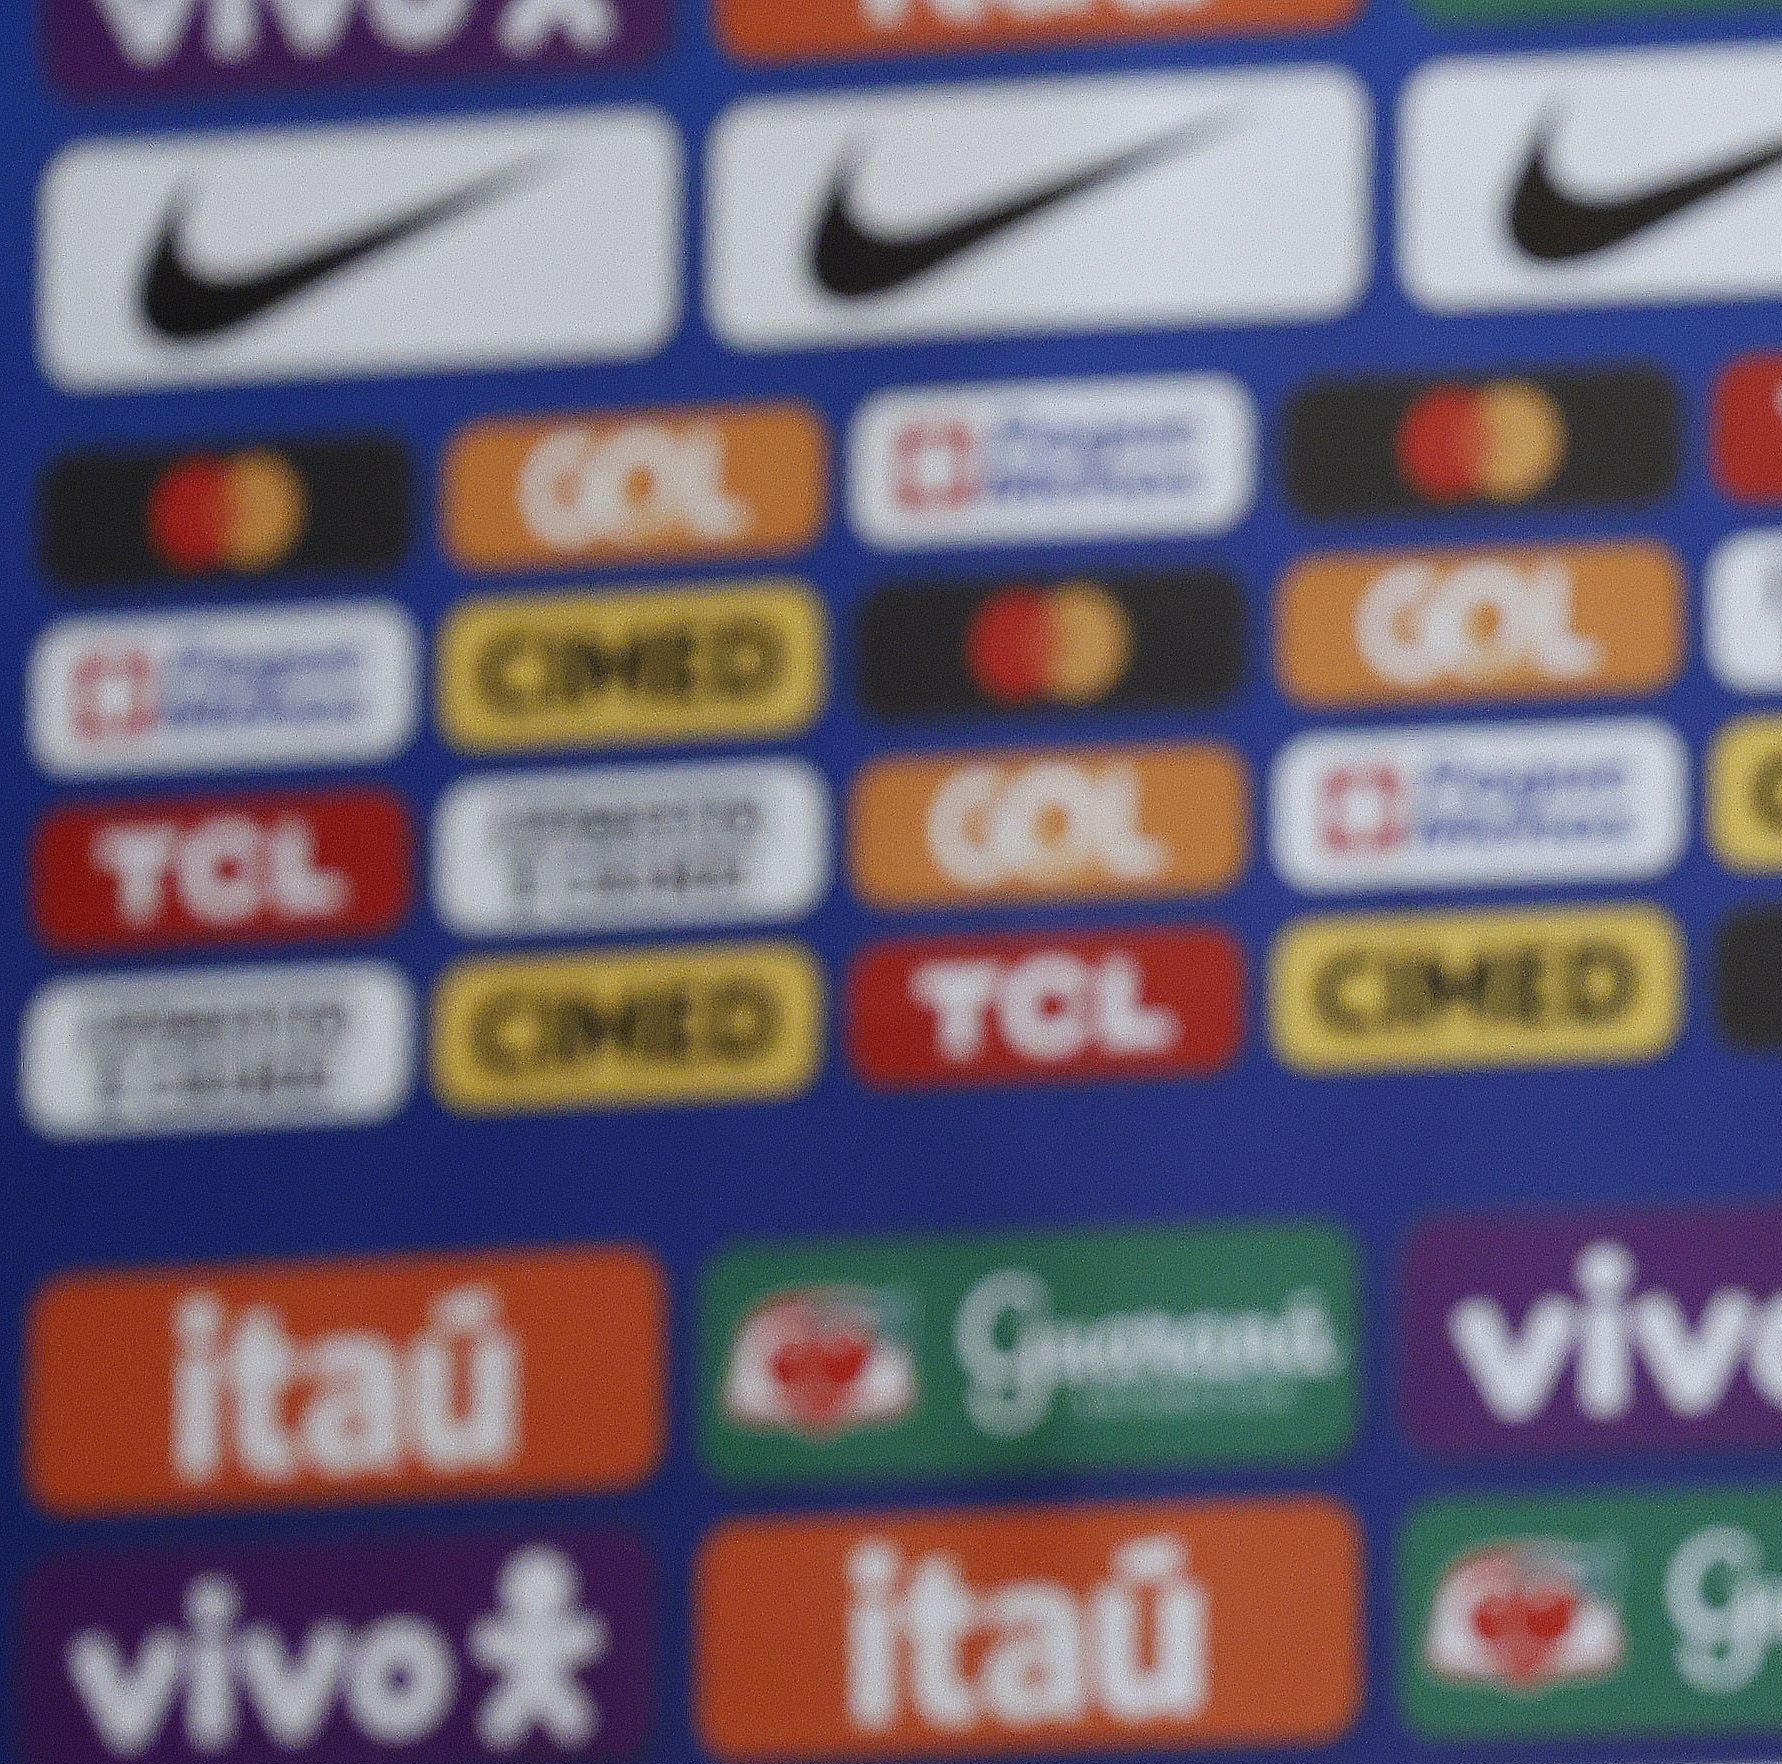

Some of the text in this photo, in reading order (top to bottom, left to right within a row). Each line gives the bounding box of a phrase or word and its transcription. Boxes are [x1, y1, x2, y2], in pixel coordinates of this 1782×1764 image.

[95, 815, 343, 923] TCL
[913, 951, 1175, 1059] TCL
[174, 1288, 519, 1480] itaú
[71, 1579, 454, 1751] vivo
[850, 1536, 1208, 1728] itaú
